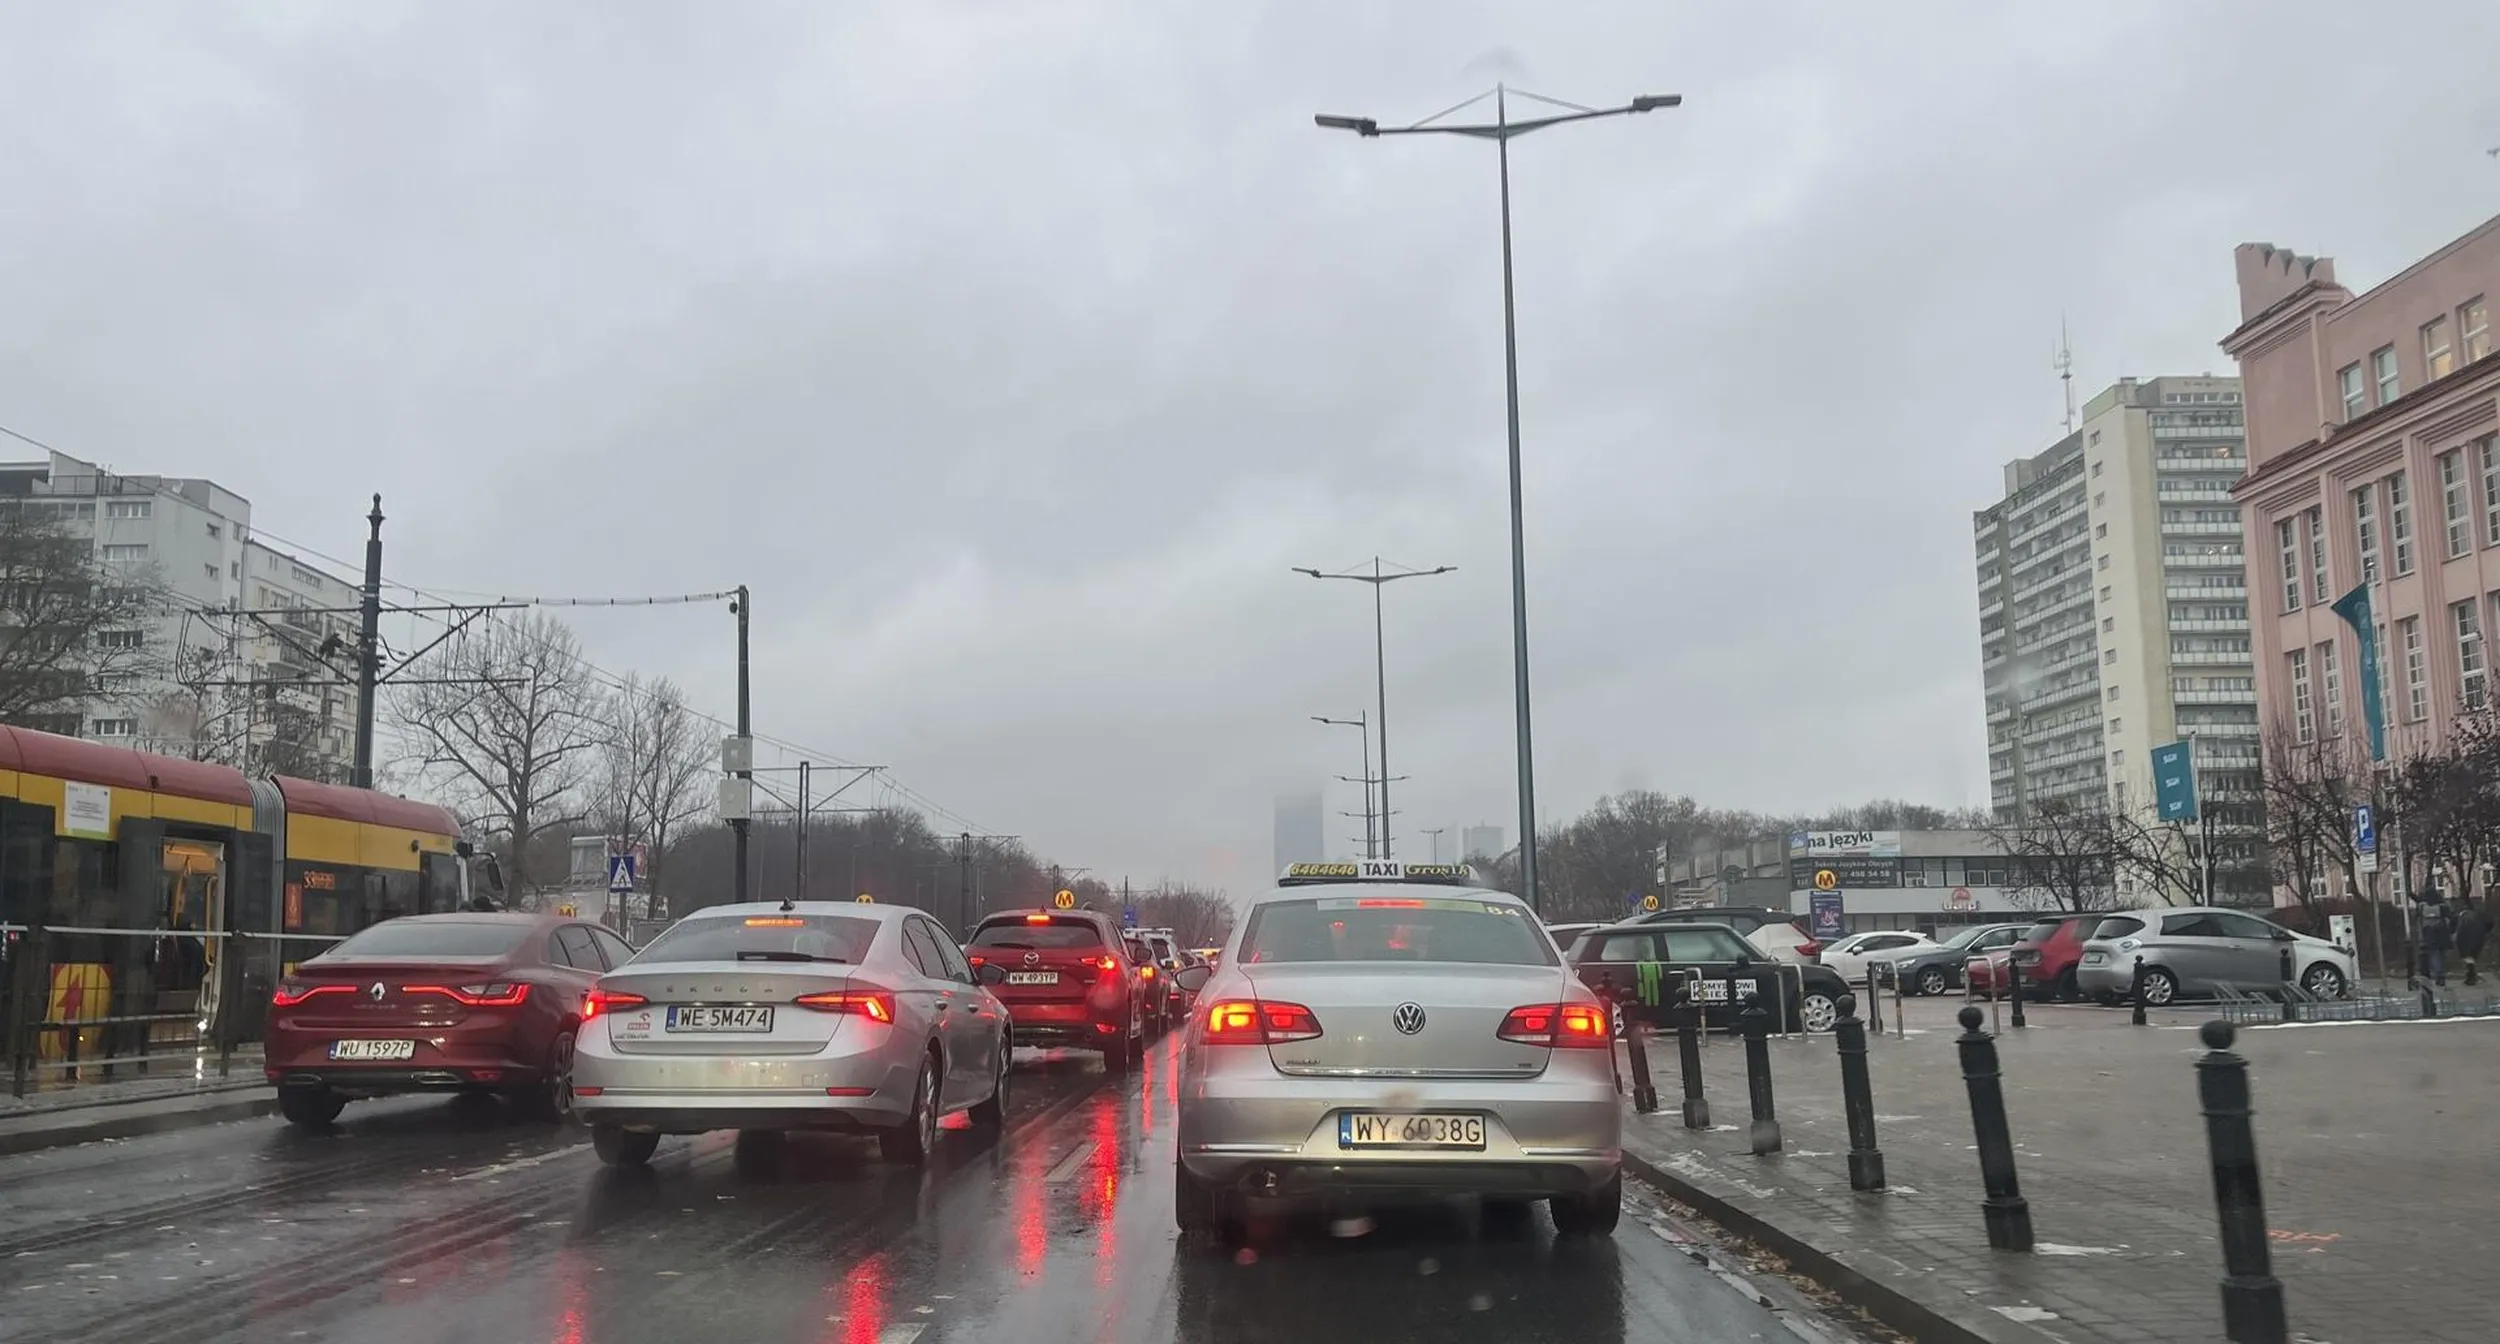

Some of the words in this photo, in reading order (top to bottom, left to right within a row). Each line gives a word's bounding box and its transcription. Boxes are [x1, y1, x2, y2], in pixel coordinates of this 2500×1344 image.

[2358, 808, 2369, 839] P
[1808, 836, 1826, 848] na
[1829, 831, 1873, 849] języki
[1363, 863, 1398, 876] TAXI
[680, 1009, 700, 1026] WE
[709, 1009, 767, 1027] 5M474
[339, 1042, 360, 1055] WU
[366, 1042, 410, 1056] 1597P
[1356, 1117, 1393, 1141] WY
[1402, 1117, 1481, 1142] 6038G
